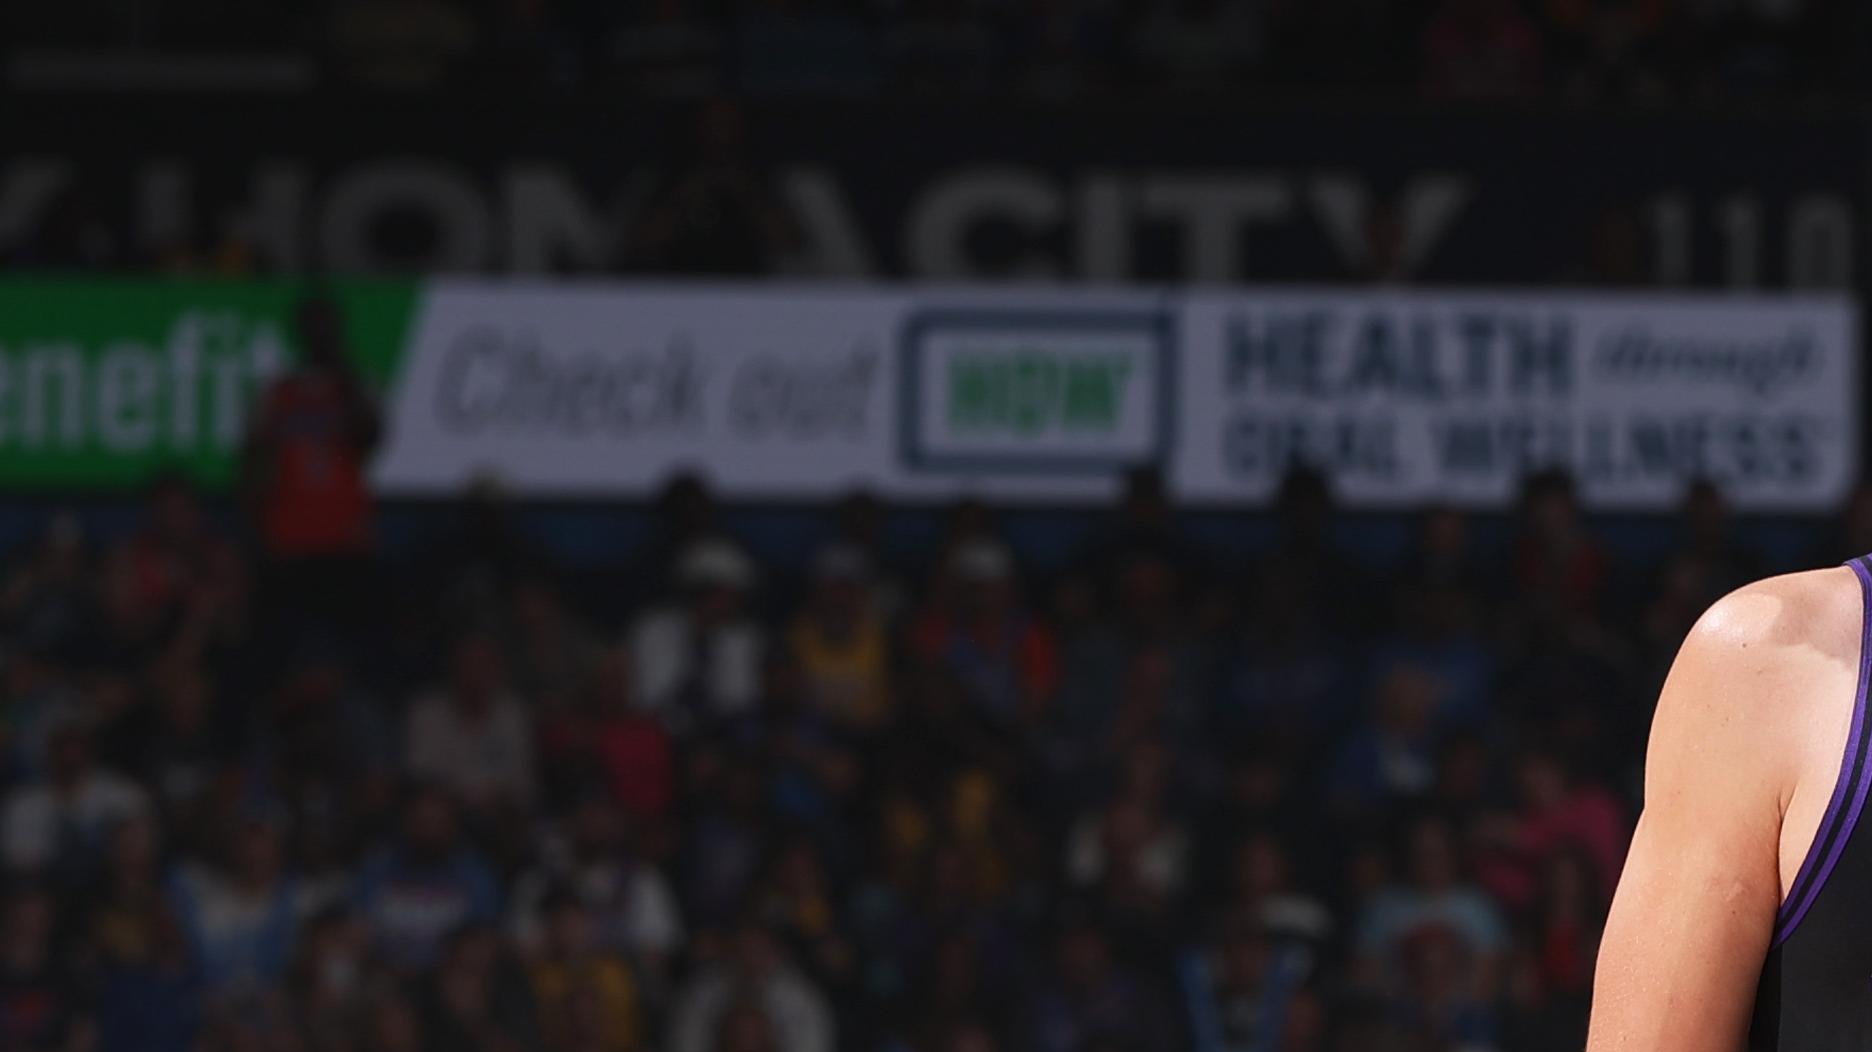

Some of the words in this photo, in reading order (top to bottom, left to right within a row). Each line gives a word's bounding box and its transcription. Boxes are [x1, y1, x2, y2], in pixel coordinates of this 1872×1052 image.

[434, 324, 702, 438] Check
[726, 333, 880, 442] out
[947, 351, 1134, 434] HOW
[1223, 314, 1574, 396] HEALTH
[1598, 325, 1818, 396] through
